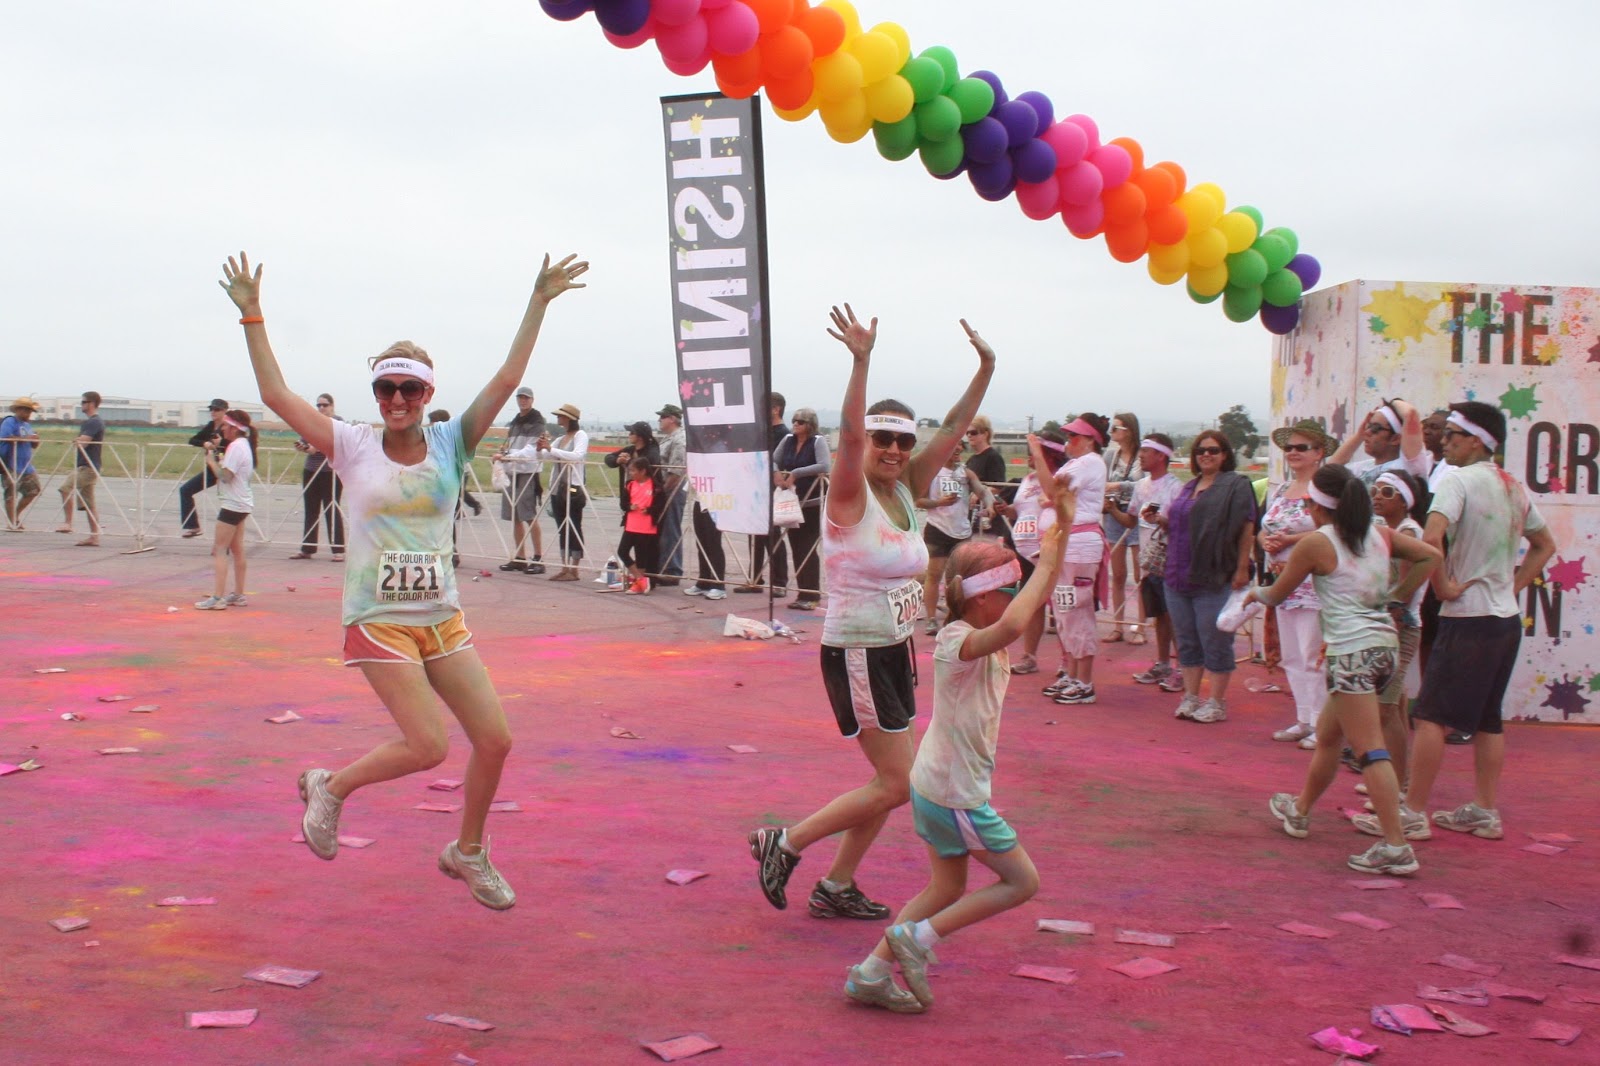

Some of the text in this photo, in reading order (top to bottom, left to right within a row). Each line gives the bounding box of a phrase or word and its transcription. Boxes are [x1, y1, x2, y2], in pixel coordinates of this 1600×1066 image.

[1440, 291, 1553, 366] THE
[1494, 421, 1600, 495] OR
[384, 553, 437, 564] THE COLOR RUN
[381, 564, 439, 591] 2121
[382, 591, 440, 601] THE COLOR RUN
